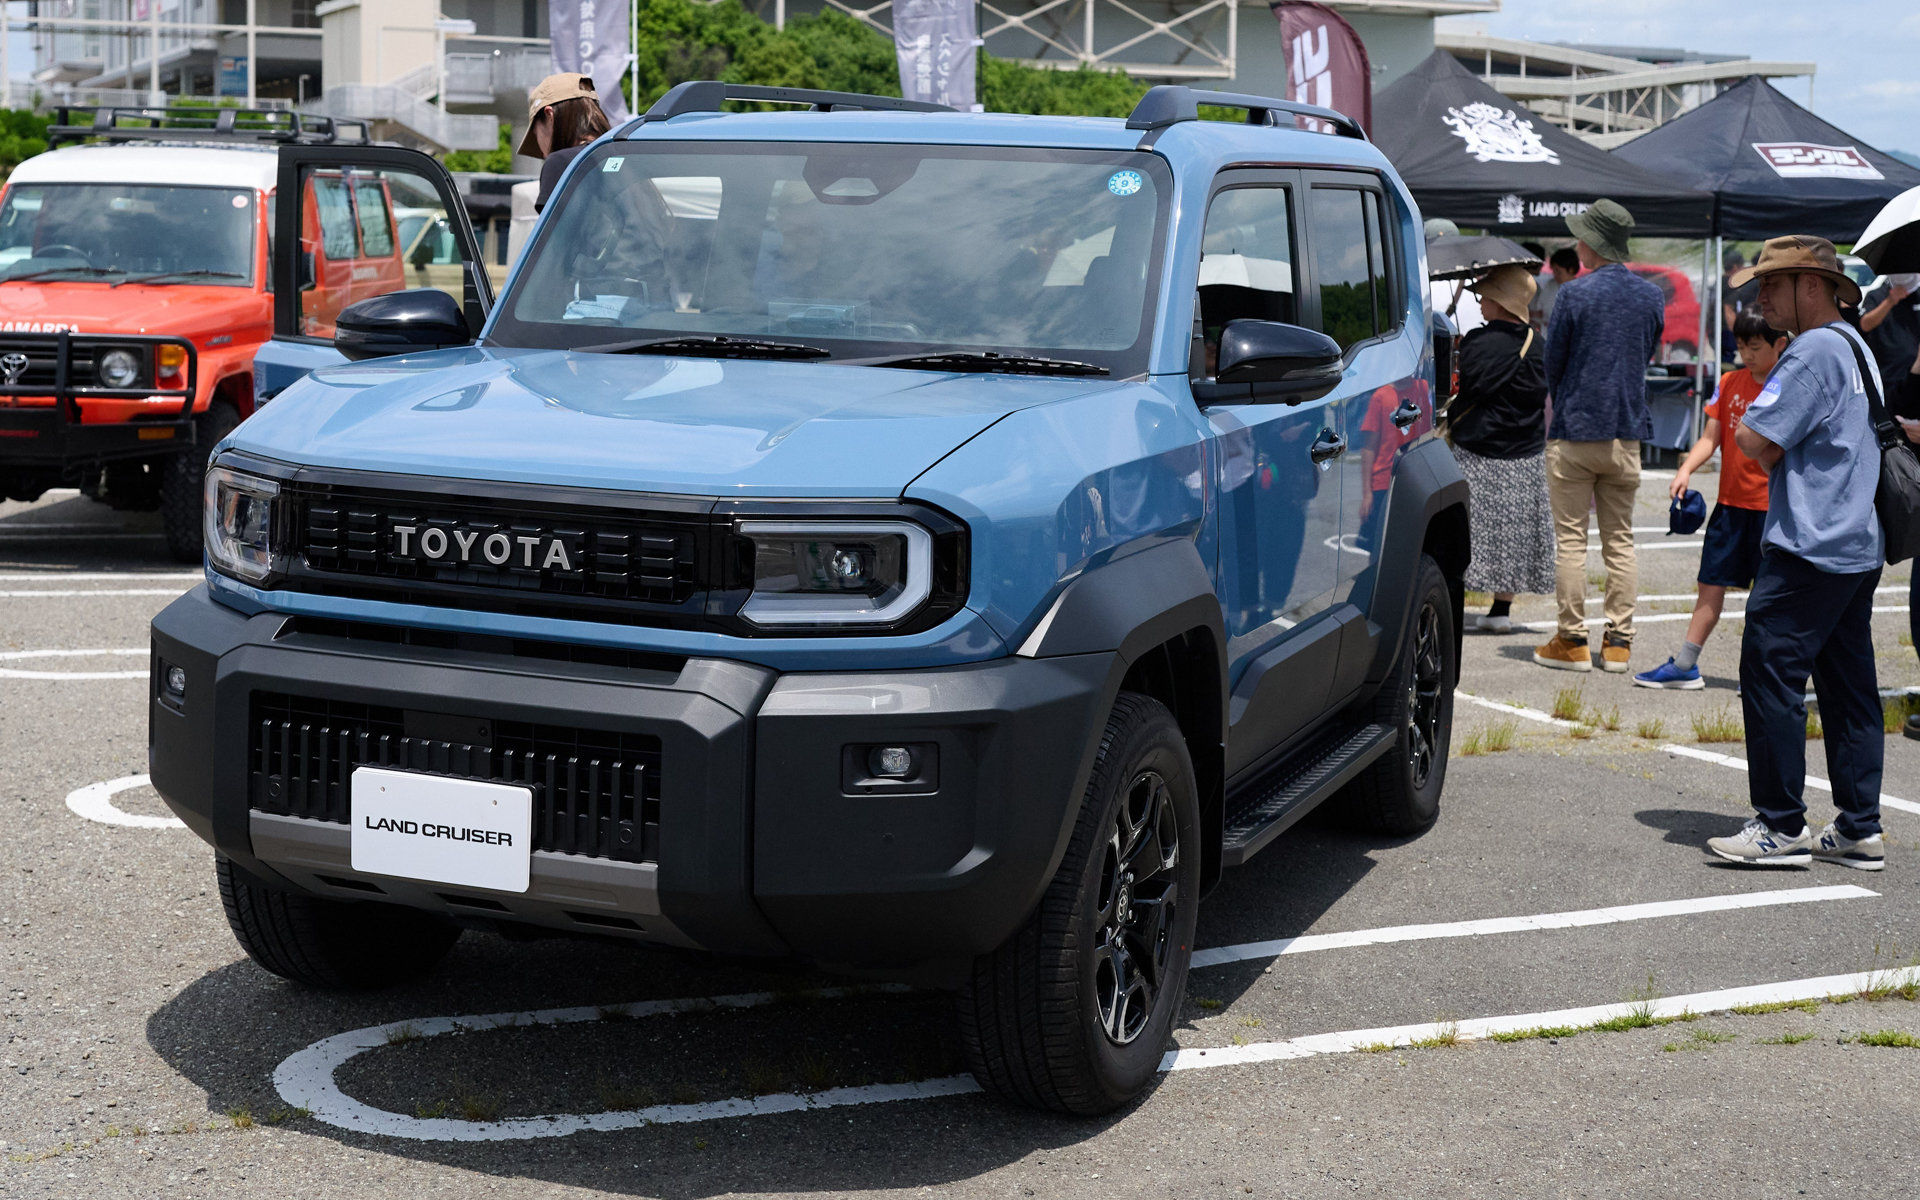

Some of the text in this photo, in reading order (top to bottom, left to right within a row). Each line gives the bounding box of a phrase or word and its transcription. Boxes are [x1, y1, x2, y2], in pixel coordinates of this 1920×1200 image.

[1768, 148, 1859, 166] ランクル
[1529, 202, 1559, 217] LAND
[394, 525, 571, 571] TOYOTA
[366, 816, 513, 847] LAND CRUISER
[1755, 835, 1779, 853] N
